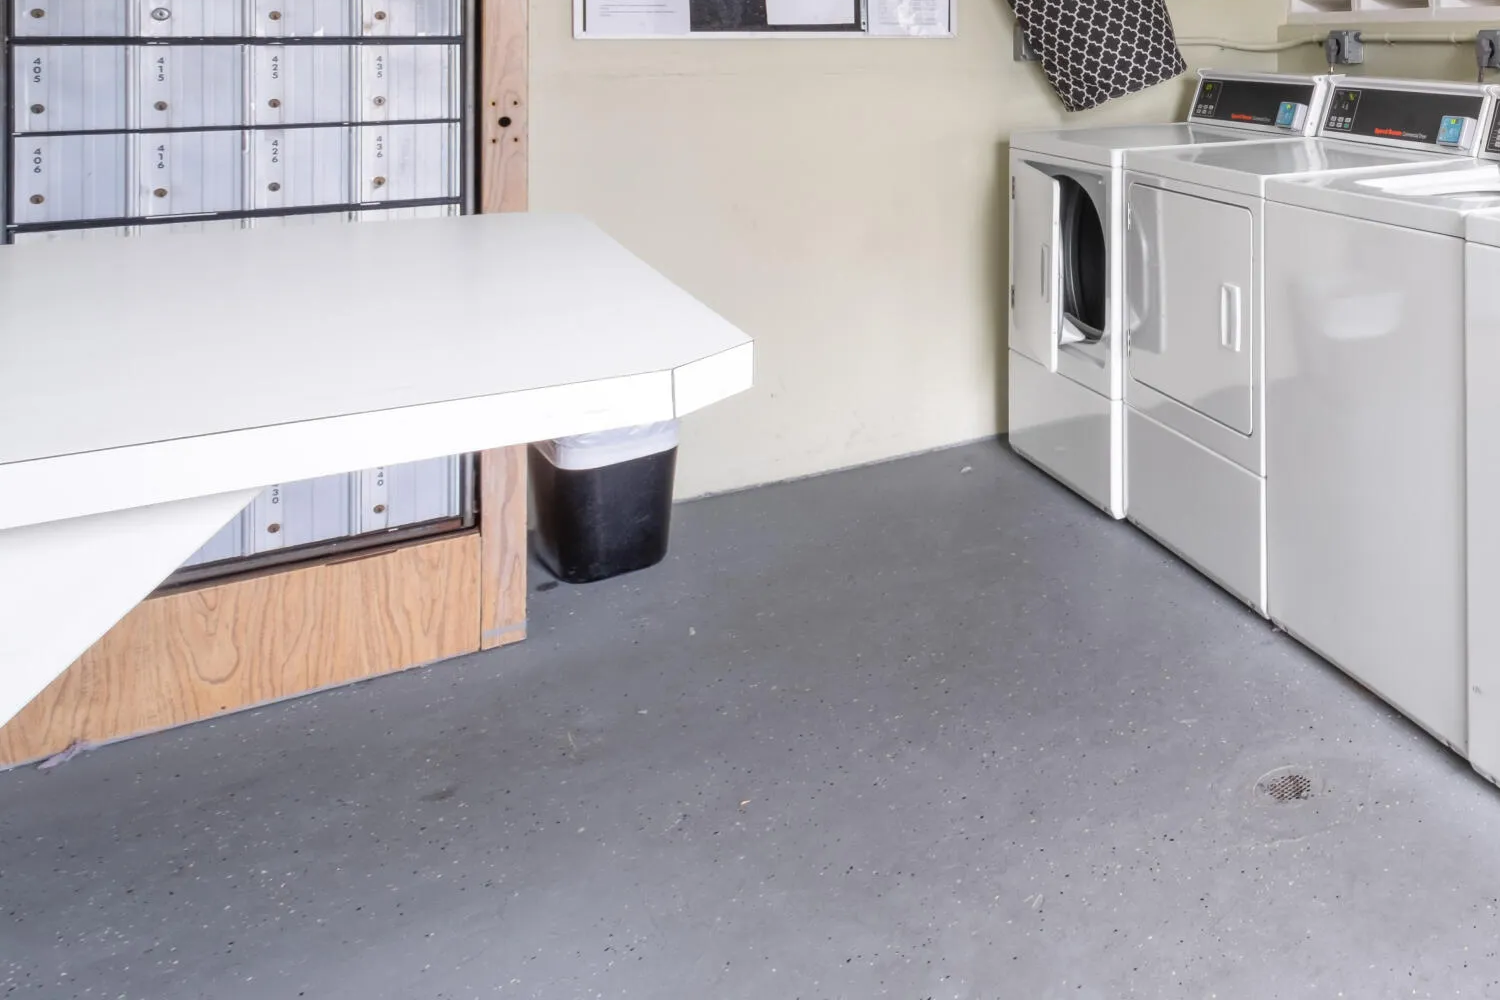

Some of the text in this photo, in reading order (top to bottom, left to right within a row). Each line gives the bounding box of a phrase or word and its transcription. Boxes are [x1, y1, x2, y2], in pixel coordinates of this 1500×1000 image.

[32, 57, 41, 83] 405
[157, 57, 165, 82] 415
[271, 55, 279, 79] 425
[376, 56, 384, 79] 435
[157, 144, 165, 169] 416
[271, 139, 279, 163] 426
[376, 136, 384, 158] 436
[33, 148, 42, 174] 406
